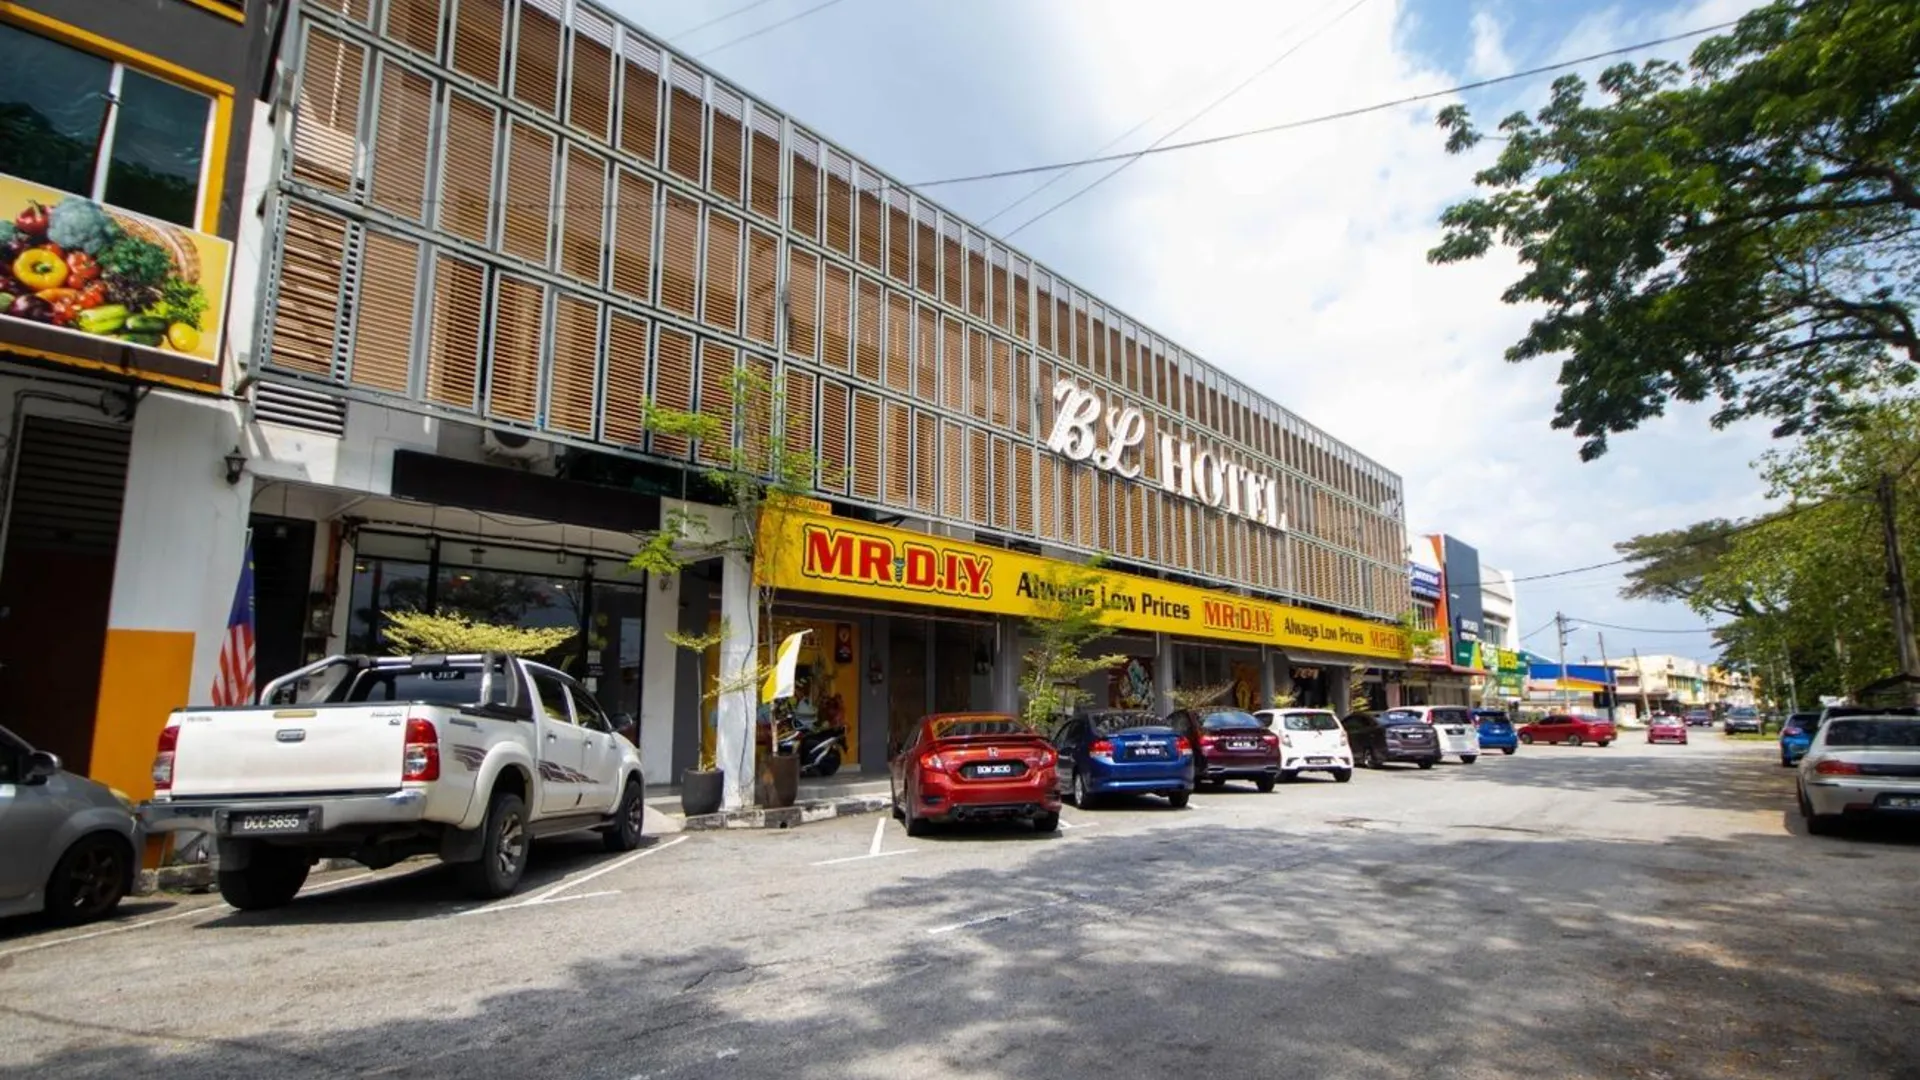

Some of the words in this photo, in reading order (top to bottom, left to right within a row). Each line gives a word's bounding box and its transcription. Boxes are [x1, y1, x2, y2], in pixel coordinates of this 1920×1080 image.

[1047, 379, 1145, 478] BL
[1157, 430, 1287, 531] HOTEL
[1142, 593, 1191, 620] Prices
[1285, 617, 1319, 642] Always
[1320, 624, 1338, 641] Low
[1340, 627, 1365, 645] Prices
